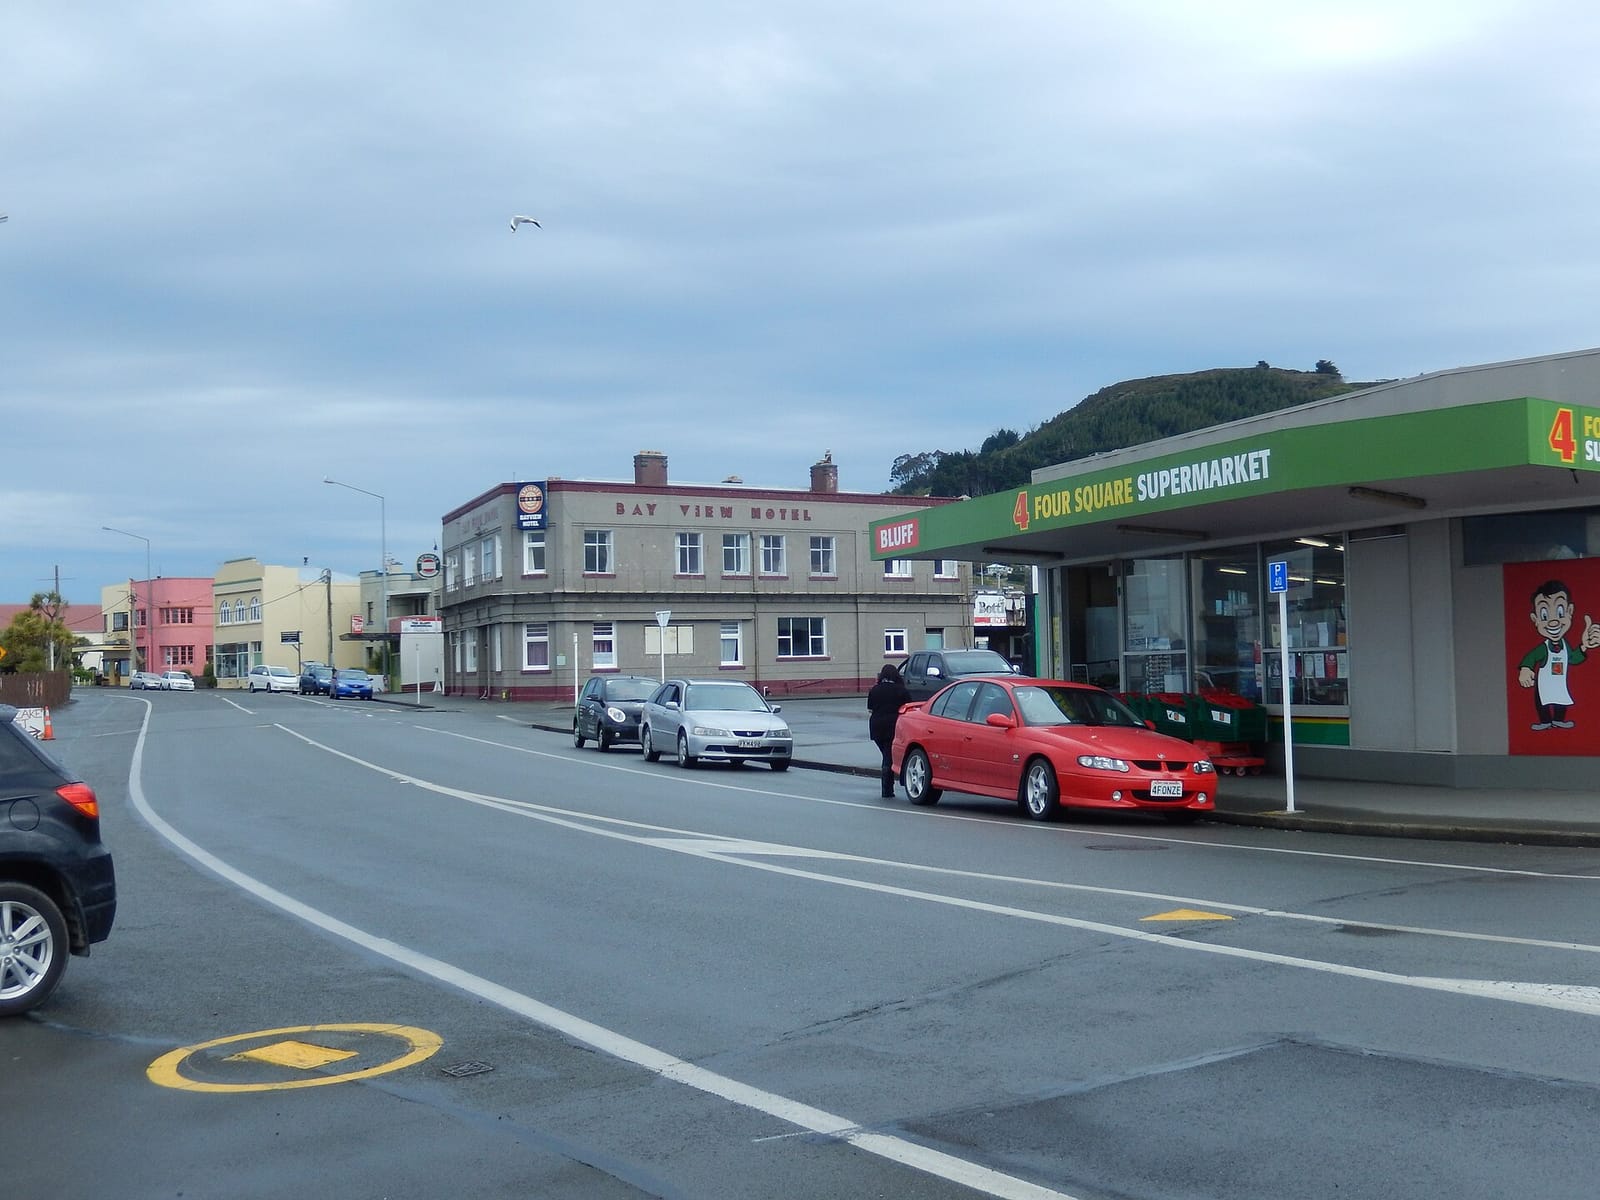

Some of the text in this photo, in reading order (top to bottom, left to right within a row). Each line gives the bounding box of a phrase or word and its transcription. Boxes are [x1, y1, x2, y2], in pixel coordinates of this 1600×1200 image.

[1034, 490, 1071, 520] FOUR
[1075, 478, 1133, 513] SQUARE
[1137, 449, 1271, 502] SUPERMARKET
[616, 503, 811, 520] BAY VIEW HOTEL
[880, 523, 914, 549] BLUFF
[1275, 565, 1281, 576] P
